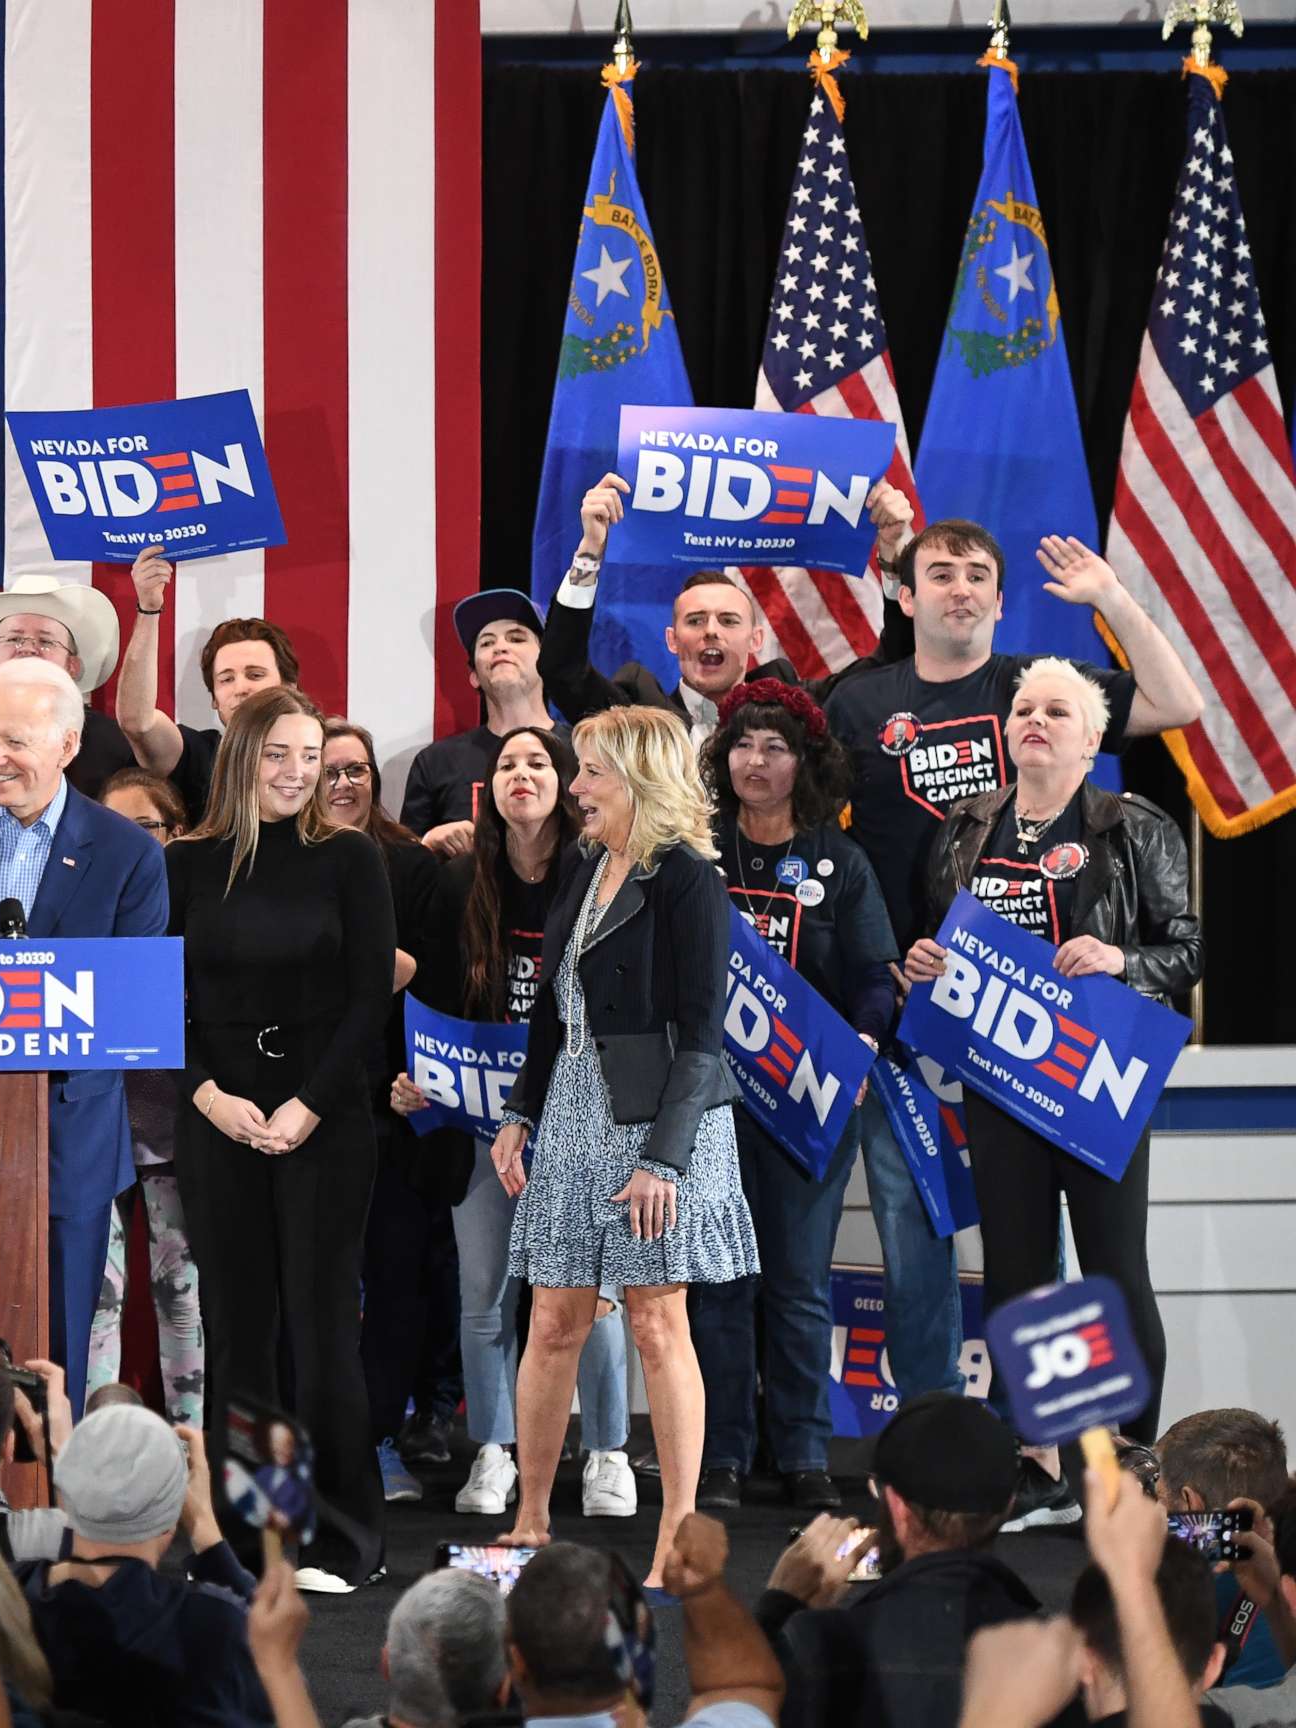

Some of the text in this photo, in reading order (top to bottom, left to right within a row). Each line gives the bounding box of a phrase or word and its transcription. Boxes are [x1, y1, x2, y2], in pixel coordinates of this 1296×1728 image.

[643, 254, 657, 302] BORN
[30, 435, 148, 456] NEVADA FOR
[640, 430, 778, 458] NEVADA FOR
[36, 443, 255, 517] BIDEN
[632, 449, 870, 528] BIDEN
[102, 524, 206, 544] Text NV to 30330
[683, 532, 795, 549] Text NV to 30330
[909, 738, 992, 772] BIDEN
[913, 763, 994, 788] PRECINCT
[926, 780, 997, 802] CAPTAIN
[0, 952, 13, 965] to
[16, 952, 55, 965] 30330
[951, 926, 1073, 1010] NEVADA FOR
[754, 974, 788, 1014] FOR
[414, 1030, 528, 1067] NEVADA FO
[930, 947, 1149, 1120] BIDEN
[737, 1065, 748, 1080] to
[747, 1075, 777, 1111] 30330
[967, 1047, 1065, 1118] Text NV to 30330
[896, 1075, 913, 1097] NV
[906, 1098, 917, 1114] to
[912, 1114, 938, 1157] 30330
[854, 1297, 884, 1311] 0330
[1025, 1322, 1115, 1390] JOE
[870, 1393, 899, 1412] OR
[1231, 1599, 1254, 1636] EOS
